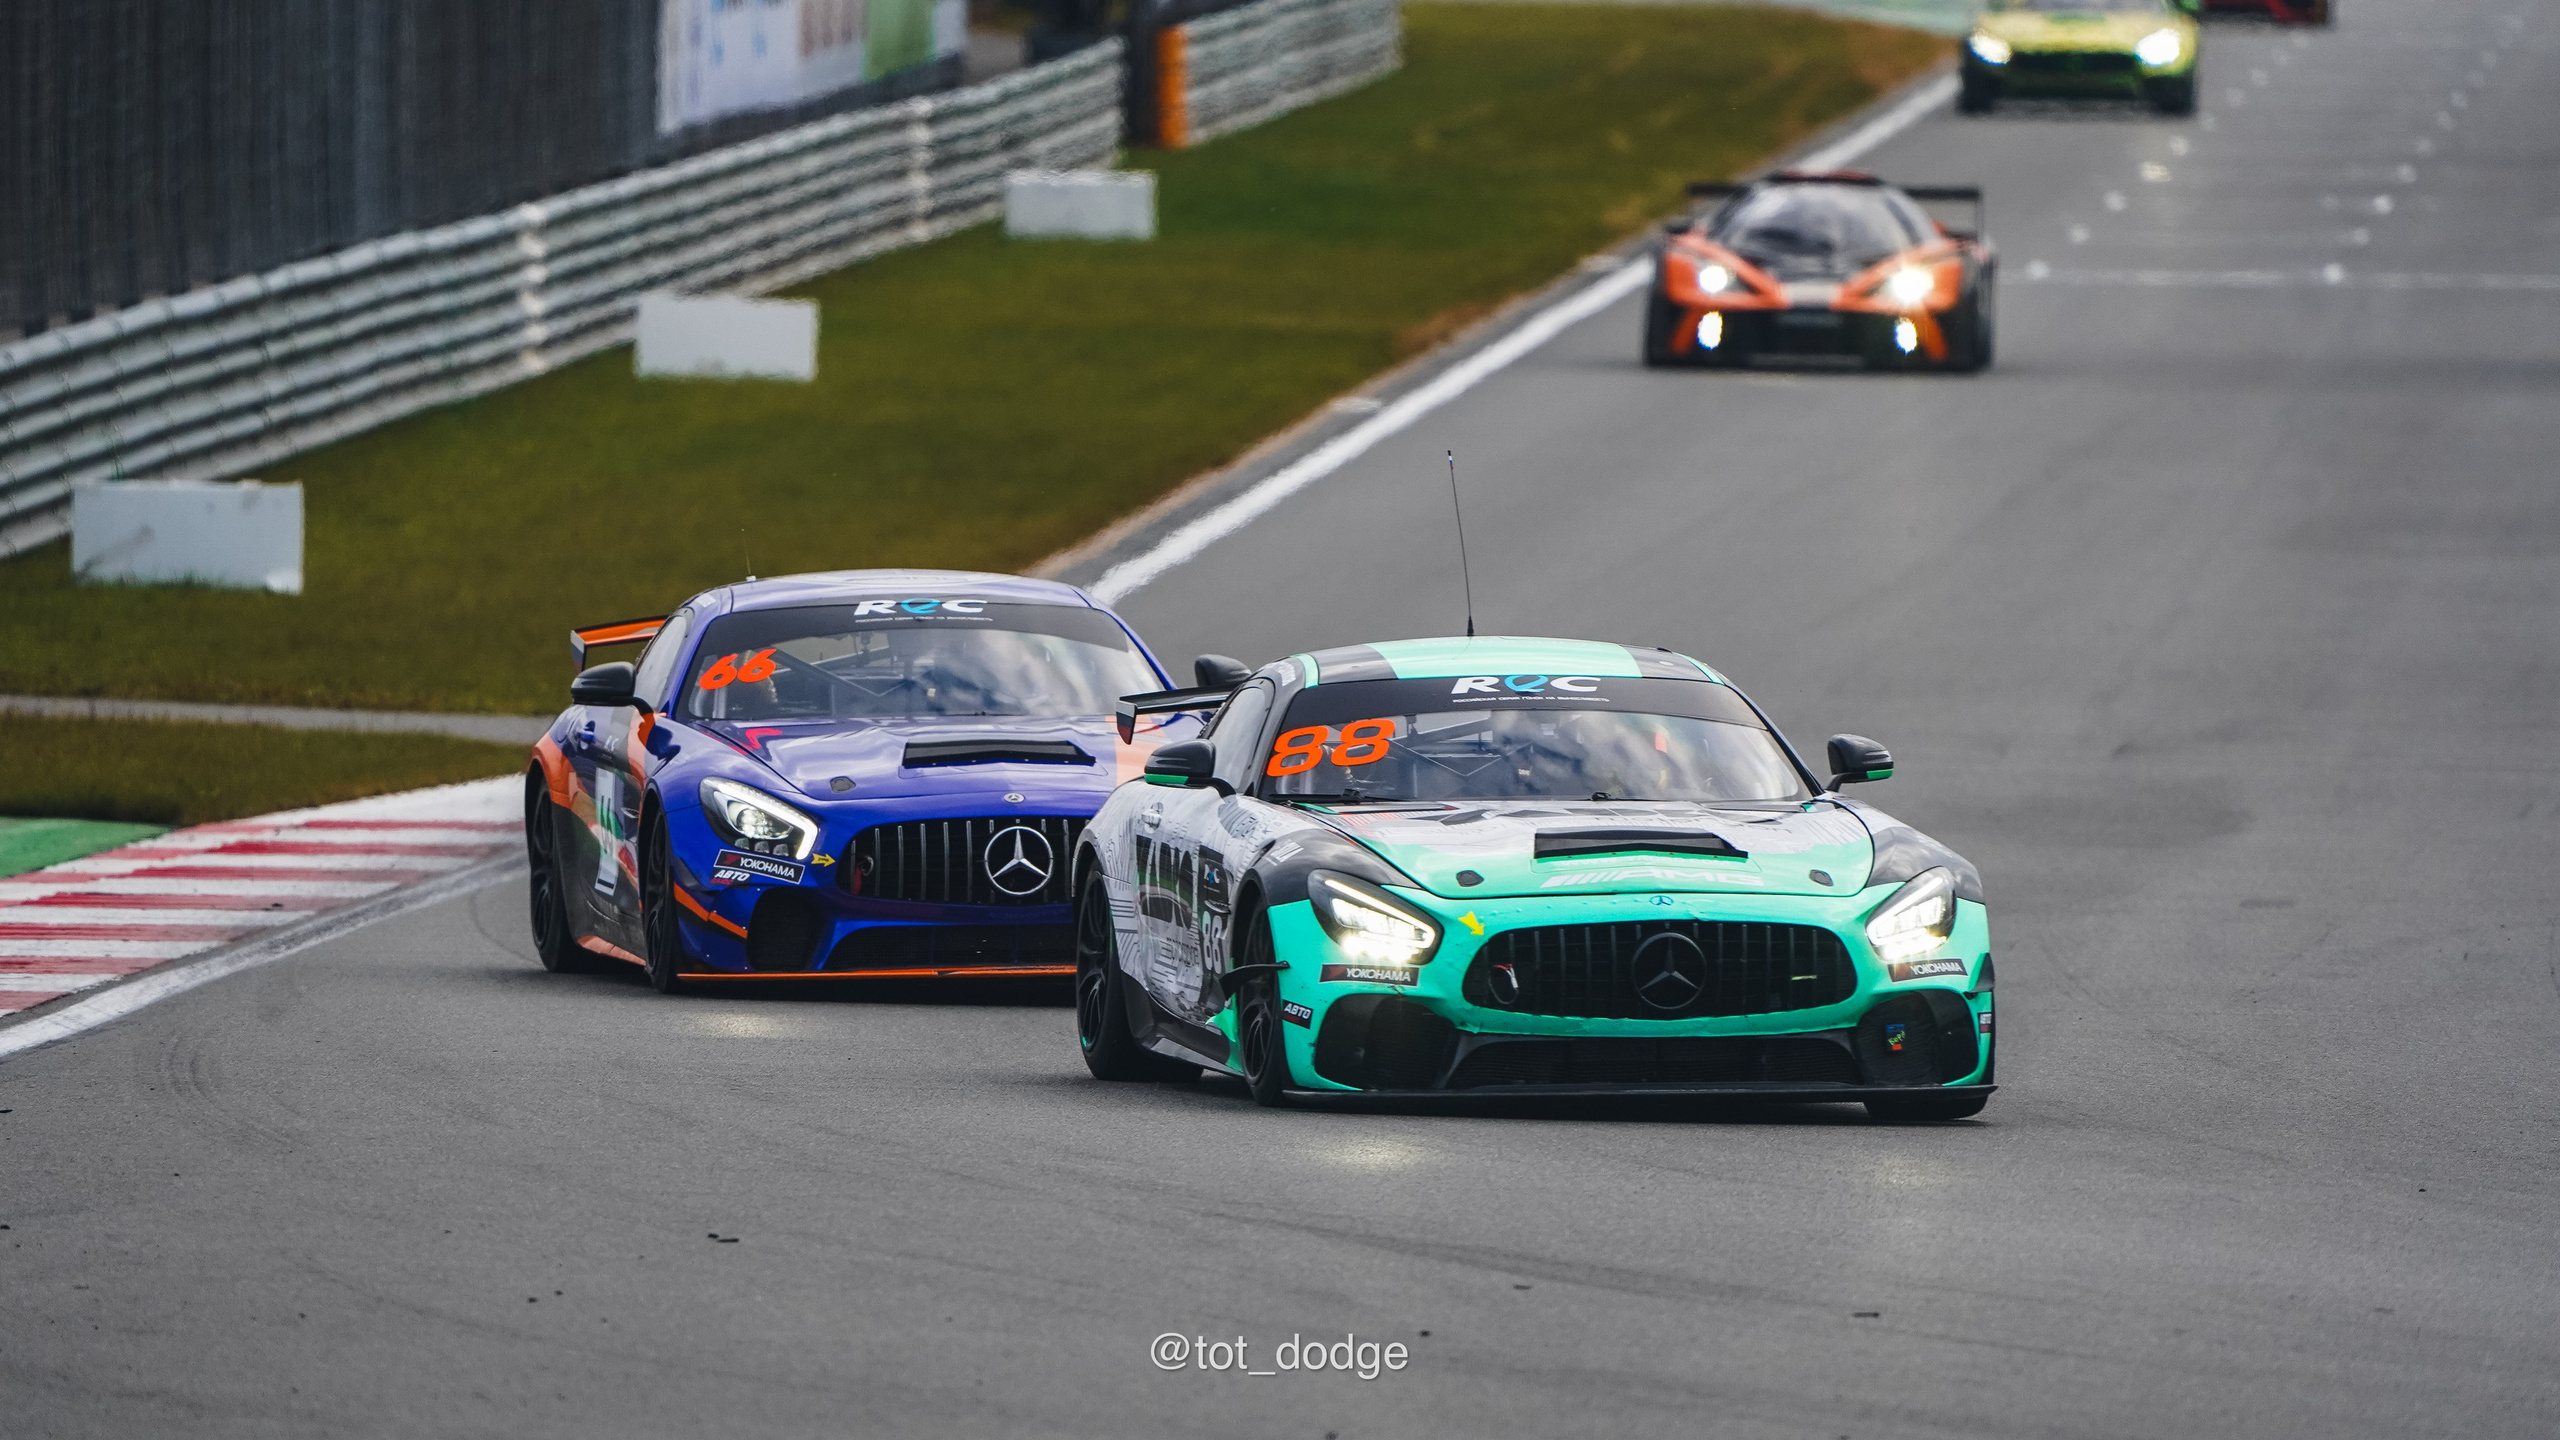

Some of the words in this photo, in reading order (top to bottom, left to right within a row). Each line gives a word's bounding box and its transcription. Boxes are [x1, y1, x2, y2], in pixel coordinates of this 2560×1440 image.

[699, 648, 777, 690] 66
[1267, 718, 1396, 777] 88
[740, 857, 795, 878] YOKOHAMA
[1612, 868, 1764, 887] AMG
[1346, 967, 1412, 982] YOKOHAMA
[1910, 962, 1964, 976] YOKOHAMA
